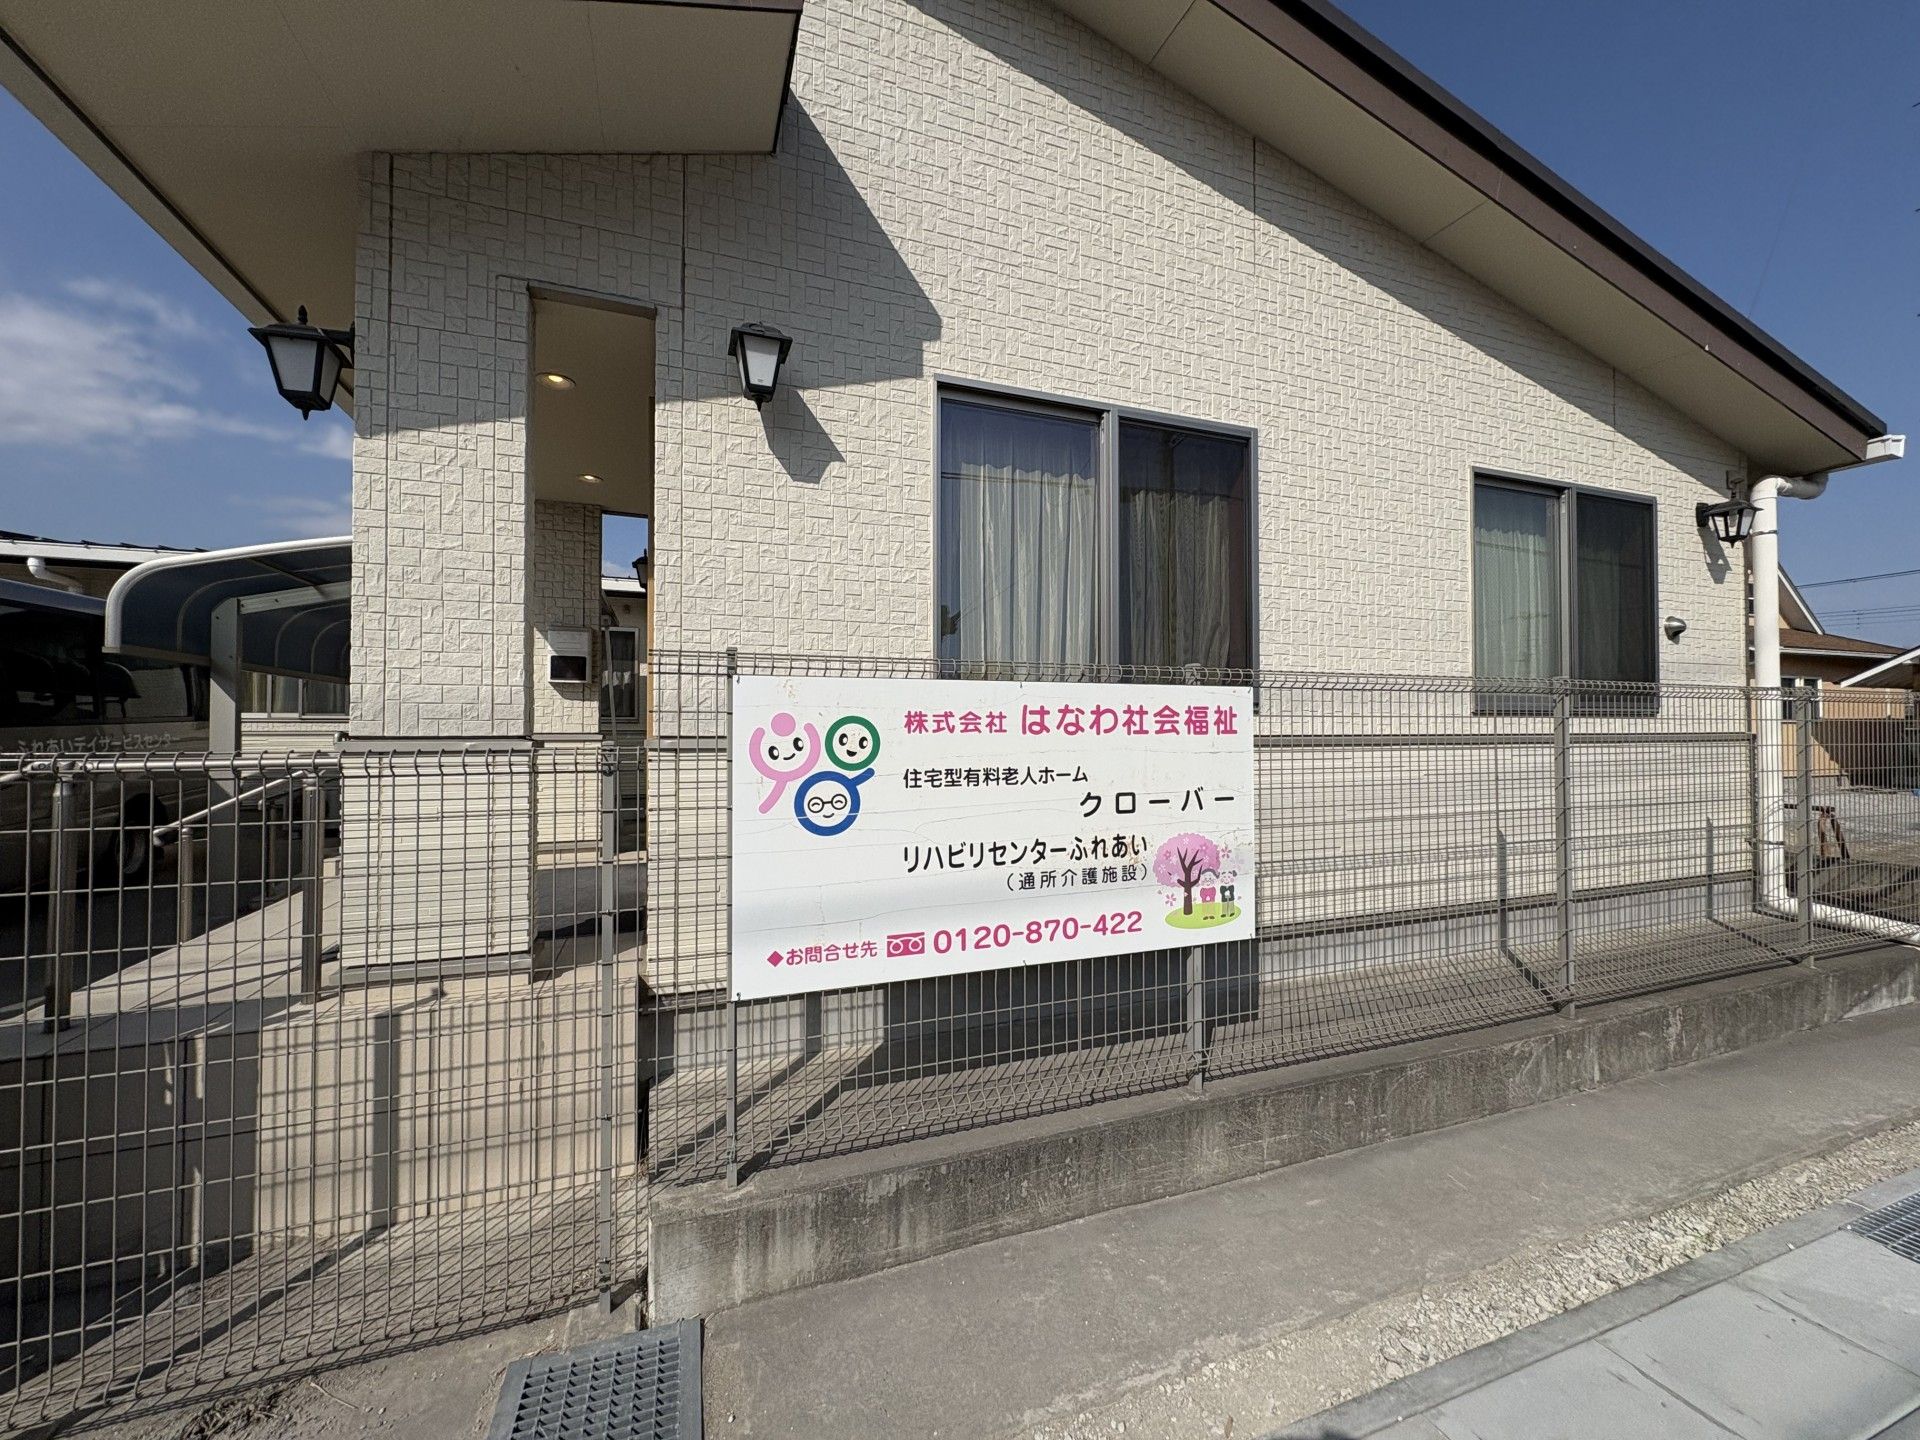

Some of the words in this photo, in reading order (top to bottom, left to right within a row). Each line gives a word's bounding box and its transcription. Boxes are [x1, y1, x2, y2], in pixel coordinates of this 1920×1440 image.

[904, 710, 1008, 735] 株式会社
[1021, 704, 1238, 737] はなわ社会福祉
[903, 766, 1089, 789] 住宅型有料老人ホーム
[1079, 786, 1236, 818] クローバー
[903, 834, 1148, 874] リハビリセンターふれあい
[933, 911, 1142, 954] 0120-870-422
